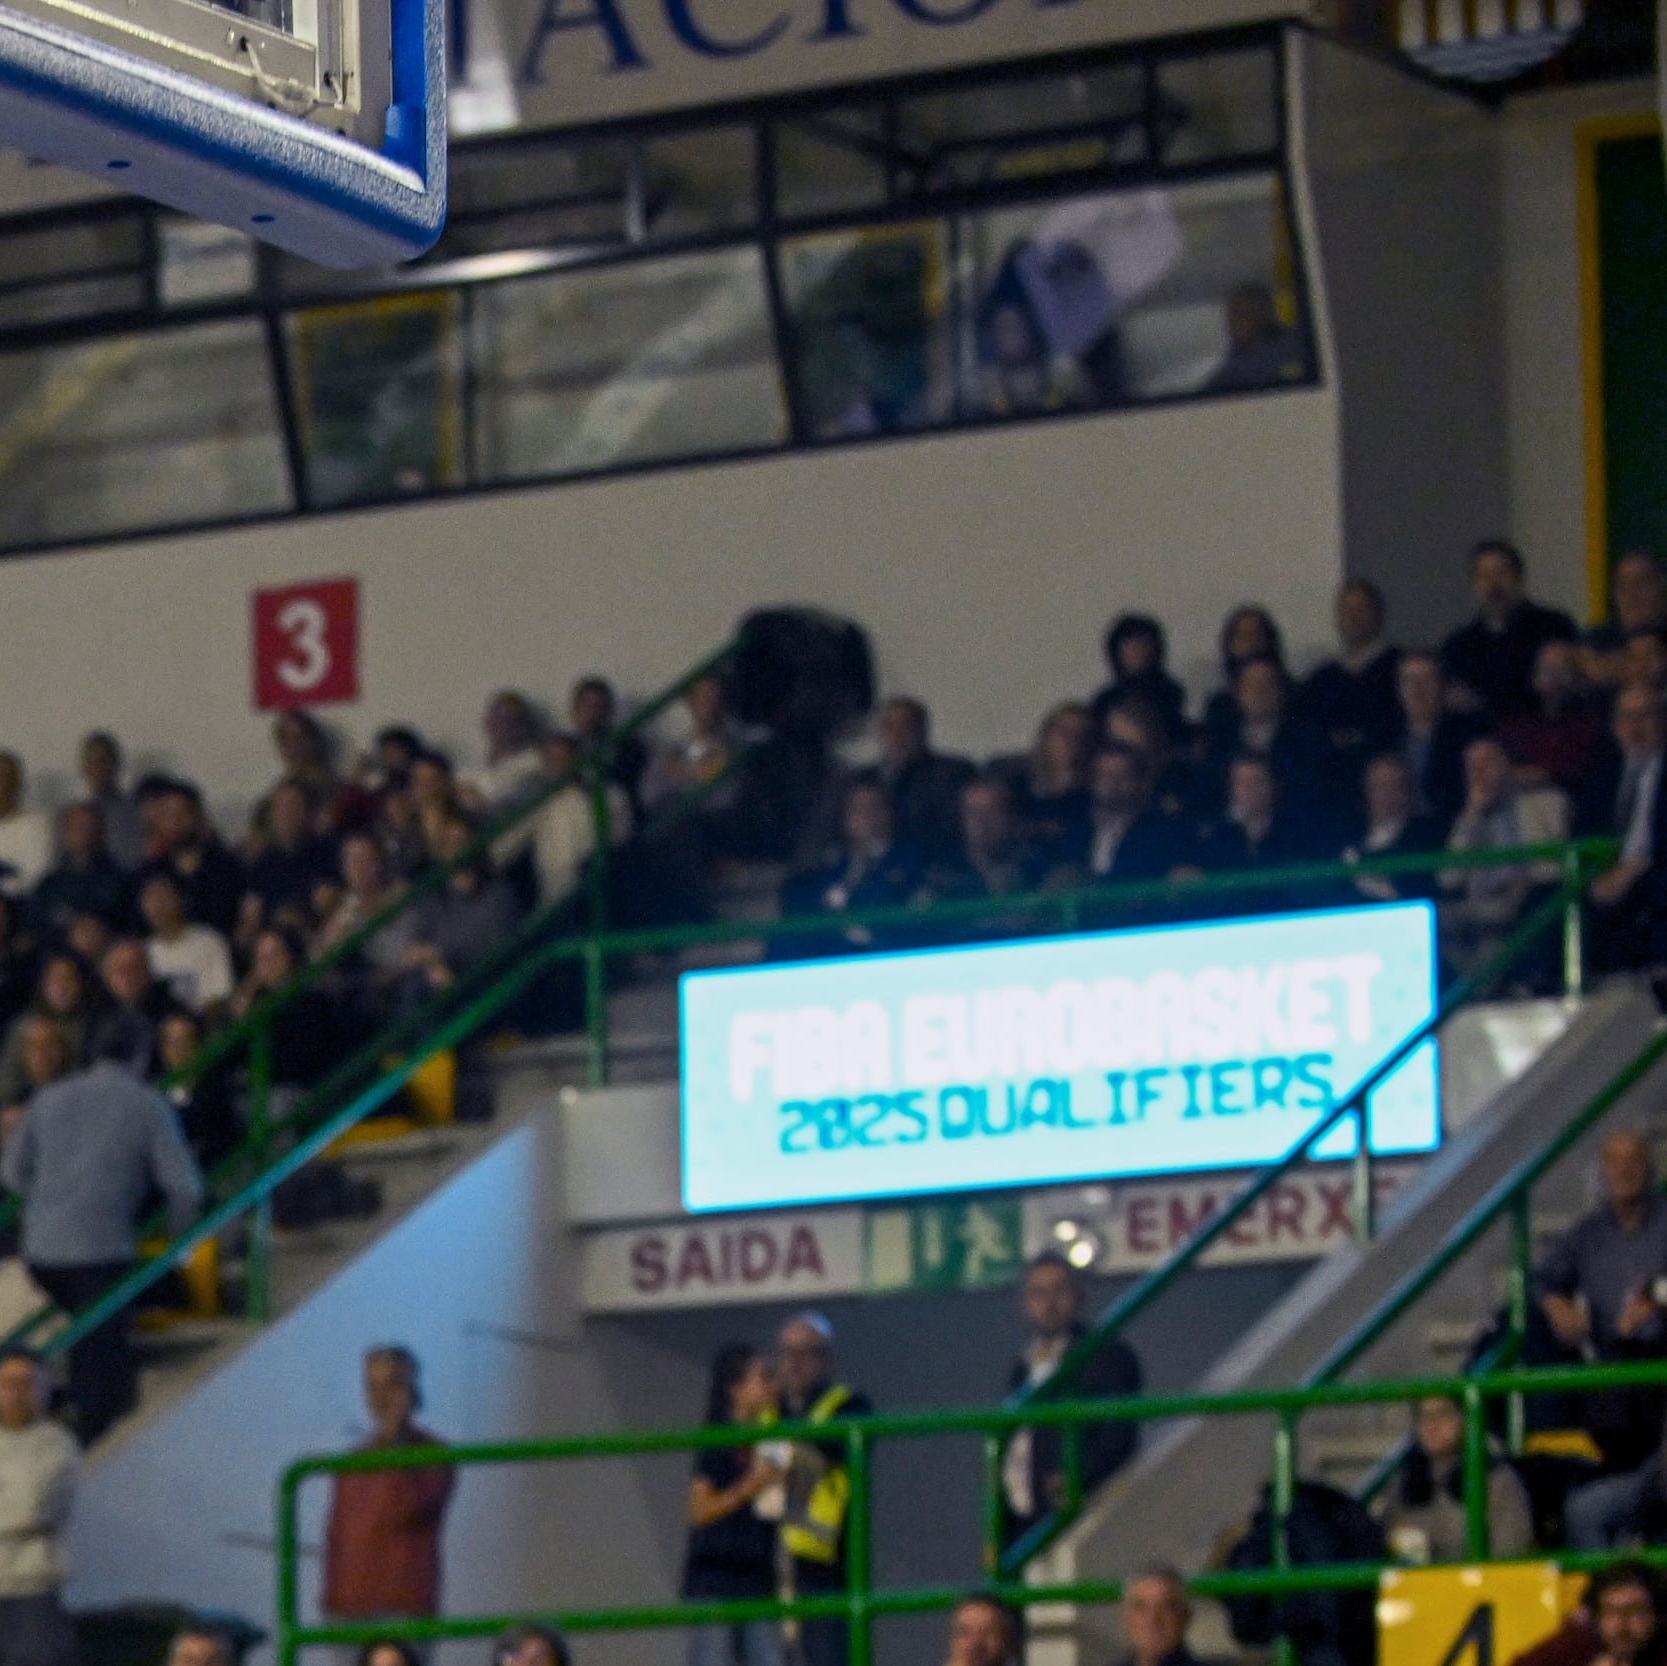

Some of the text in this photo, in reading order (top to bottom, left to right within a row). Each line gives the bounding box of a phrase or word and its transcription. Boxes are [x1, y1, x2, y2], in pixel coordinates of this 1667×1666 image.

[277, 599, 331, 690] 3
[730, 952, 1383, 1103] FIBA EUROBASKET
[630, 1224, 827, 1295] SAIDA
